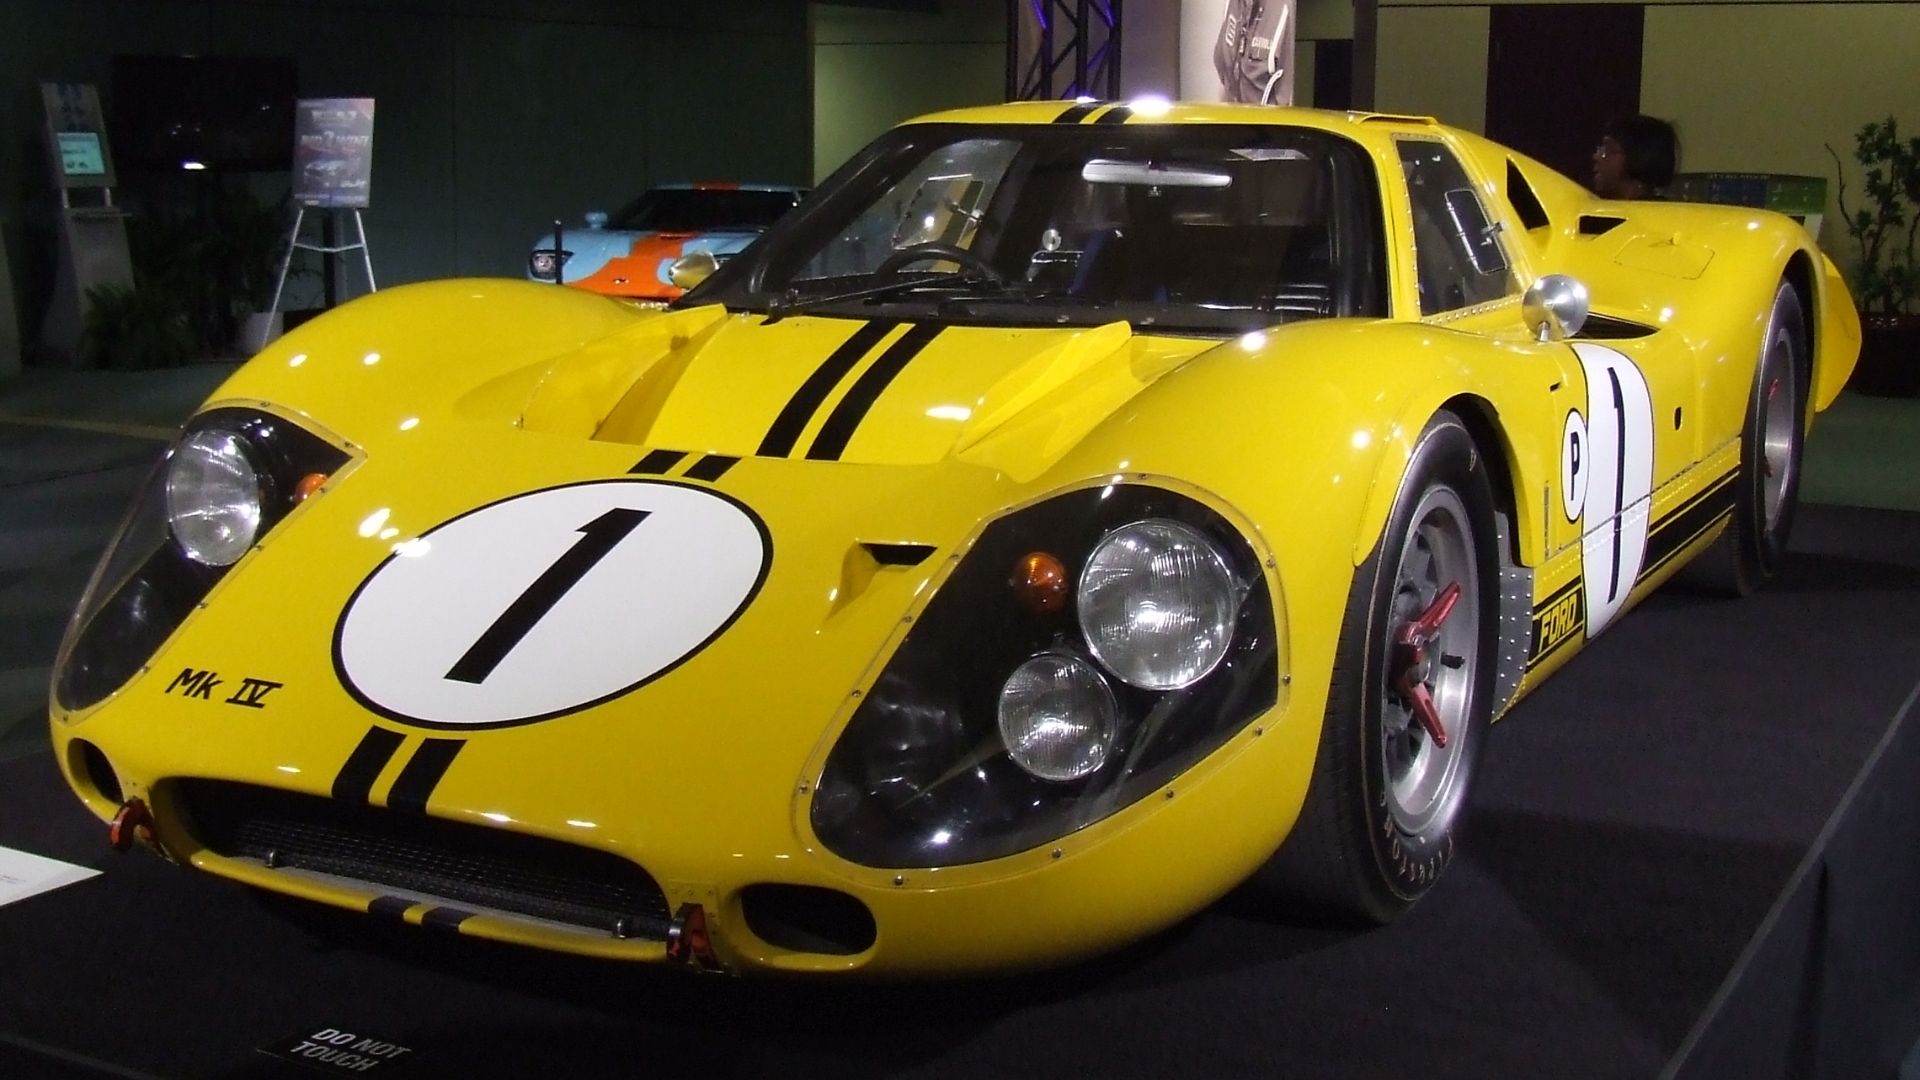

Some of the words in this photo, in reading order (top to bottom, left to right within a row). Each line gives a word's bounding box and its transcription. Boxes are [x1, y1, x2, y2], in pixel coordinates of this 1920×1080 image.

[1570, 431, 1581, 501] P
[1607, 366, 1626, 605] 1
[443, 507, 653, 684] 1
[1538, 592, 1577, 653] FORD
[224, 677, 285, 709] IV
[290, 1041, 379, 1072] TOUCH
[311, 1028, 356, 1045] DO
[350, 1038, 412, 1059] NOT
